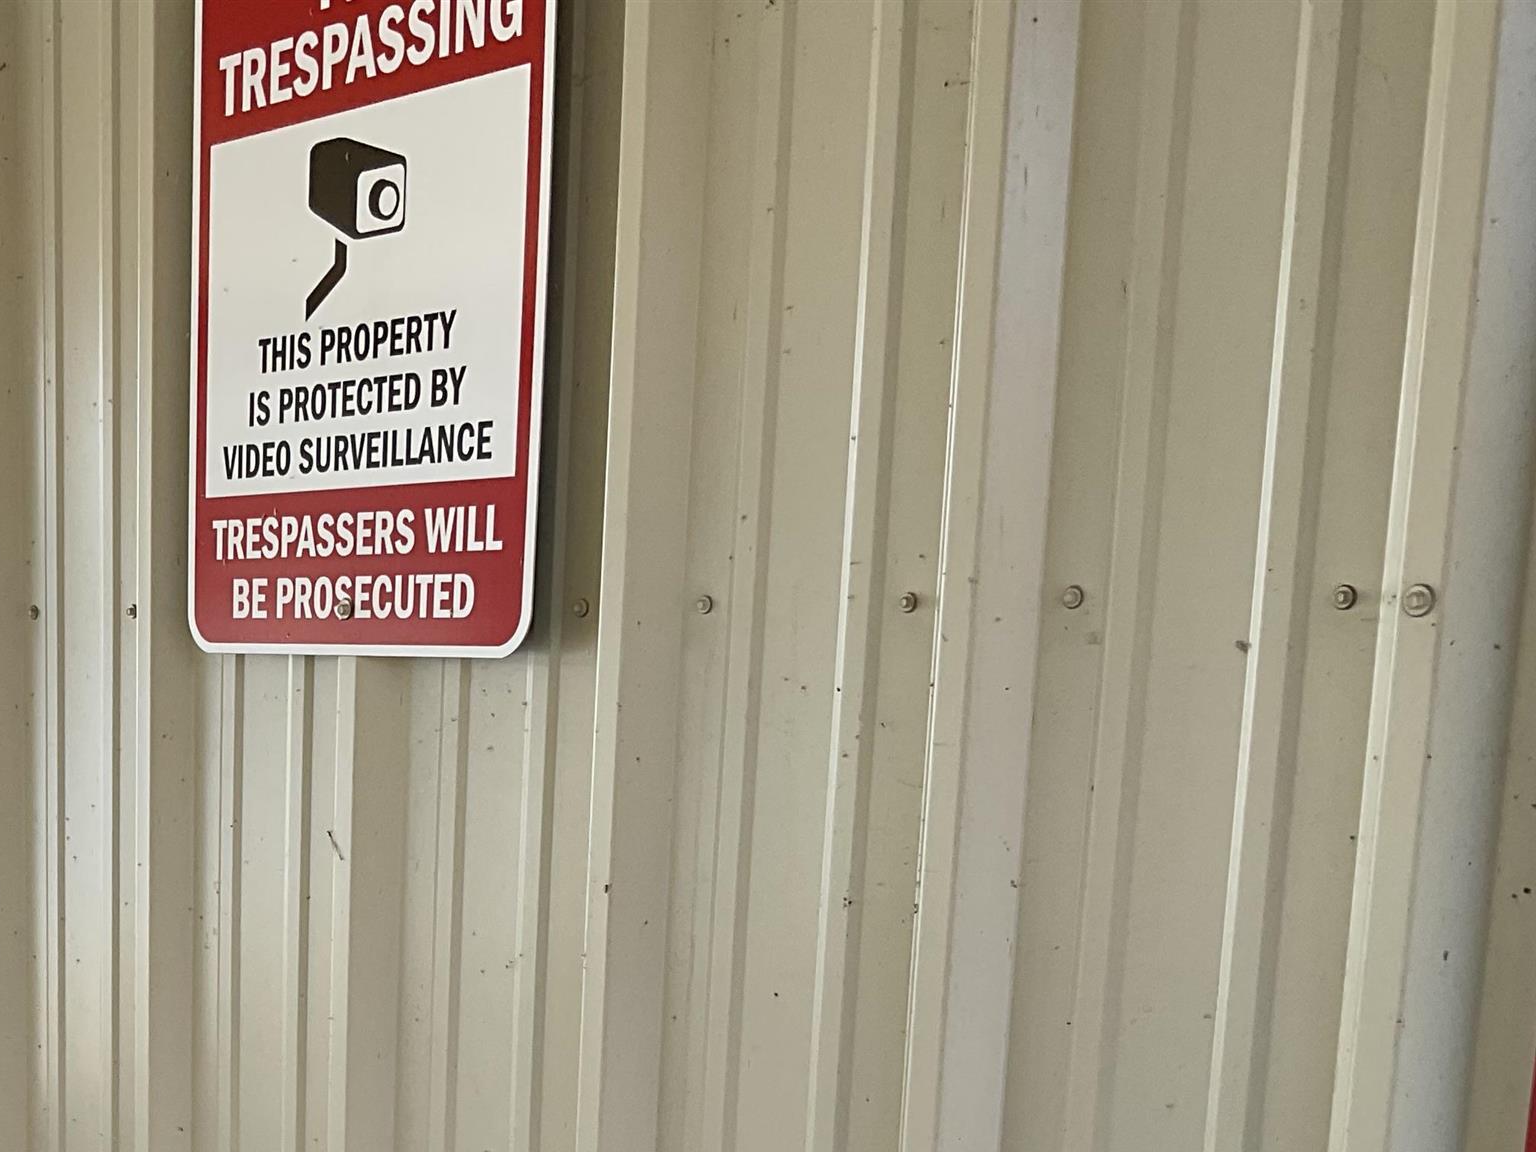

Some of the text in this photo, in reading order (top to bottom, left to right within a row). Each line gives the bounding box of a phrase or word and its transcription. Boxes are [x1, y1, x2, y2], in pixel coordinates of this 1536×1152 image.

[219, 0, 523, 117] TRESPASSING
[258, 309, 457, 374] THIS PROPERTY
[249, 365, 467, 427] IS PROTECTED BY
[223, 420, 494, 480] VIDEO SURVEILLANCE
[212, 504, 503, 561] TRESPASSERS WILL
[232, 573, 475, 620] BE PROSECUTED
